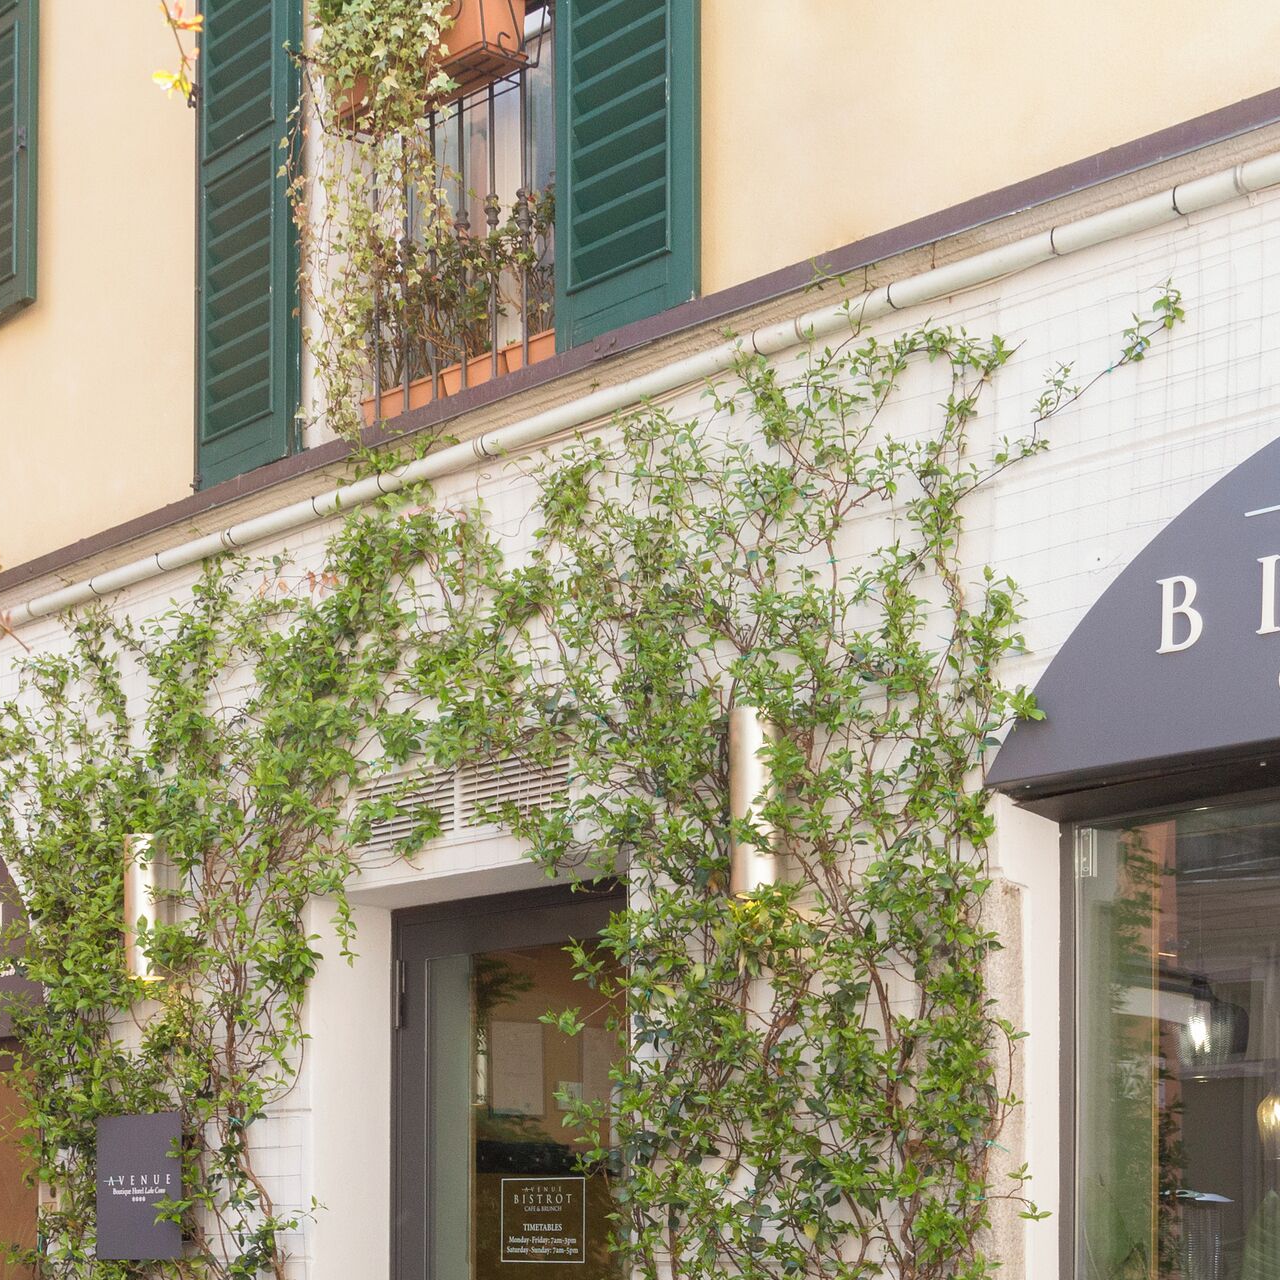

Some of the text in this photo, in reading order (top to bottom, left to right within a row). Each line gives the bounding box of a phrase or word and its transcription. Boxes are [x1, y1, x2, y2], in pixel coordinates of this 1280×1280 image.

[106, 1173, 171, 1187] AVENUE
[112, 1187, 131, 1197] Boutique
[131, 1187, 145, 1195] Hotel
[513, 1193, 573, 1205] BISTROT
[522, 1223, 563, 1232] TIMETABLES
